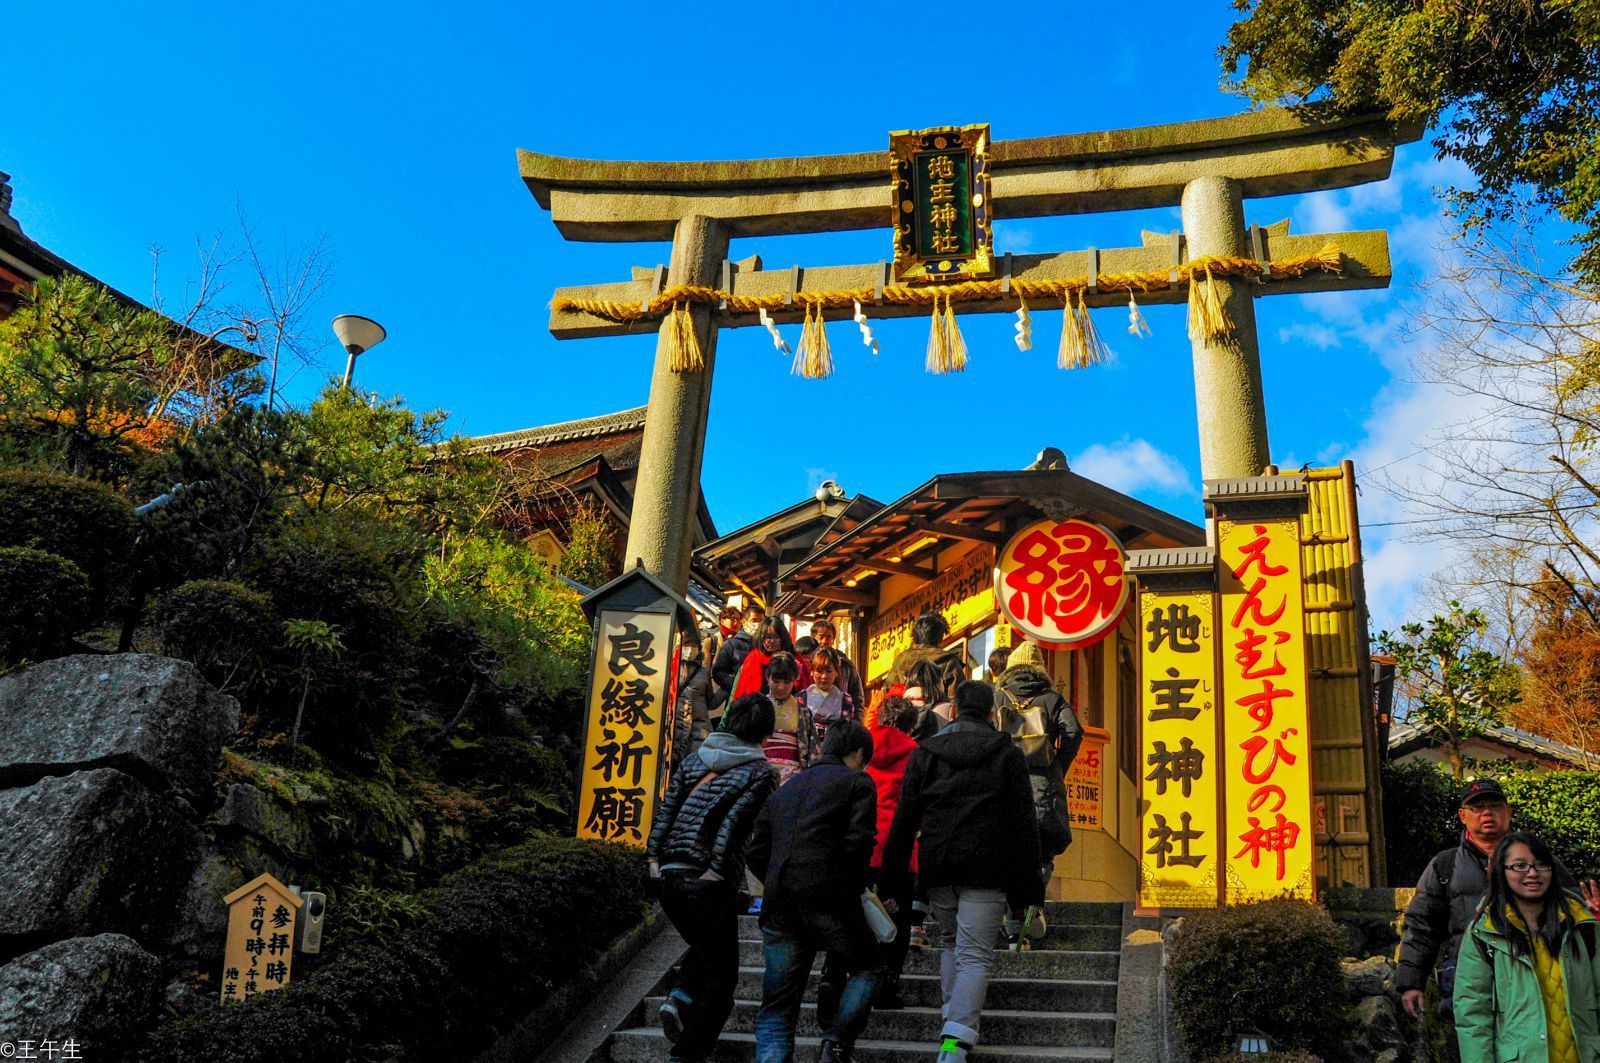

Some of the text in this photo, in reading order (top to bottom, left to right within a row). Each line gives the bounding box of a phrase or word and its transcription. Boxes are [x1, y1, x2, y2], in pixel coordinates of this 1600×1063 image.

[928, 156, 959, 254] 地主神社
[1006, 522, 1124, 634] 縁
[584, 622, 658, 841] 良縁祈願
[1145, 604, 1208, 868] 地主神社
[1231, 525, 1301, 880] えんむすびの神
[1076, 785, 1099, 802] STONE
[264, 904, 293, 994] 参拝時
